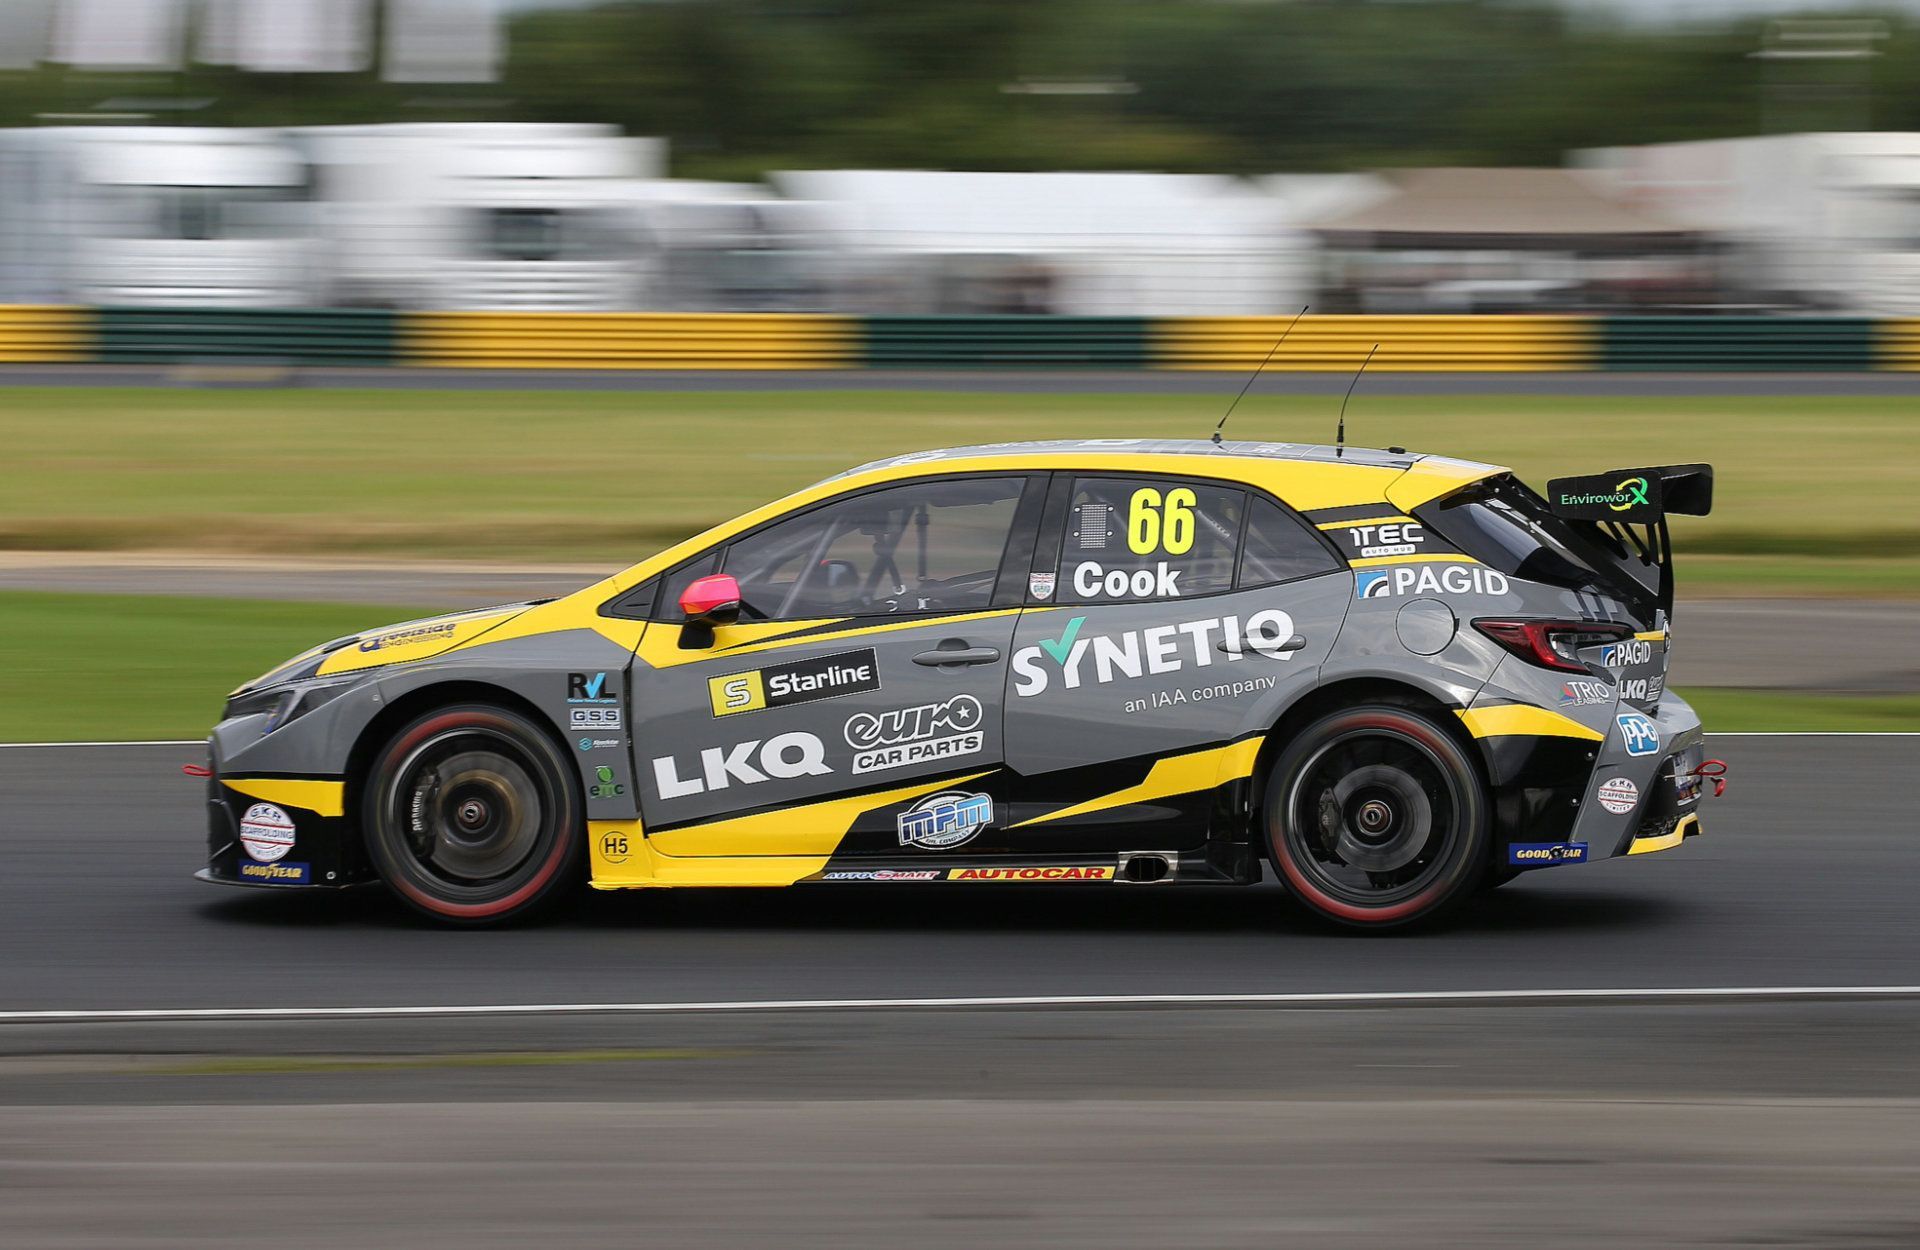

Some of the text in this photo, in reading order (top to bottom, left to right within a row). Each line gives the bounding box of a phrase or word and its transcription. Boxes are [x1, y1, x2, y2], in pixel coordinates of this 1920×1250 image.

[1128, 487, 1197, 555] 66
[1365, 547, 1390, 555] AUTO
[1074, 561, 1182, 598] Cook
[1394, 565, 1510, 596] PAGID
[1012, 609, 1295, 697] SYNETIQ
[1616, 641, 1652, 666] PAGID
[567, 672, 617, 699] RVL
[724, 664, 872, 707] S Starline
[1125, 676, 1277, 713] an IAA company
[1567, 681, 1610, 699] TRIO
[1619, 679, 1647, 700] LKQ
[573, 710, 617, 721] GSS
[844, 693, 983, 751] euro
[652, 731, 835, 800] LKQ
[858, 736, 979, 770] CAR PARTS
[1599, 790, 1638, 801] SCAFFOLDING
[605, 837, 628, 854] H5
[1516, 846, 1581, 860] GOODEAR
[242, 862, 303, 880] GOODYEAR
[957, 867, 1106, 880] AUTOCAR
